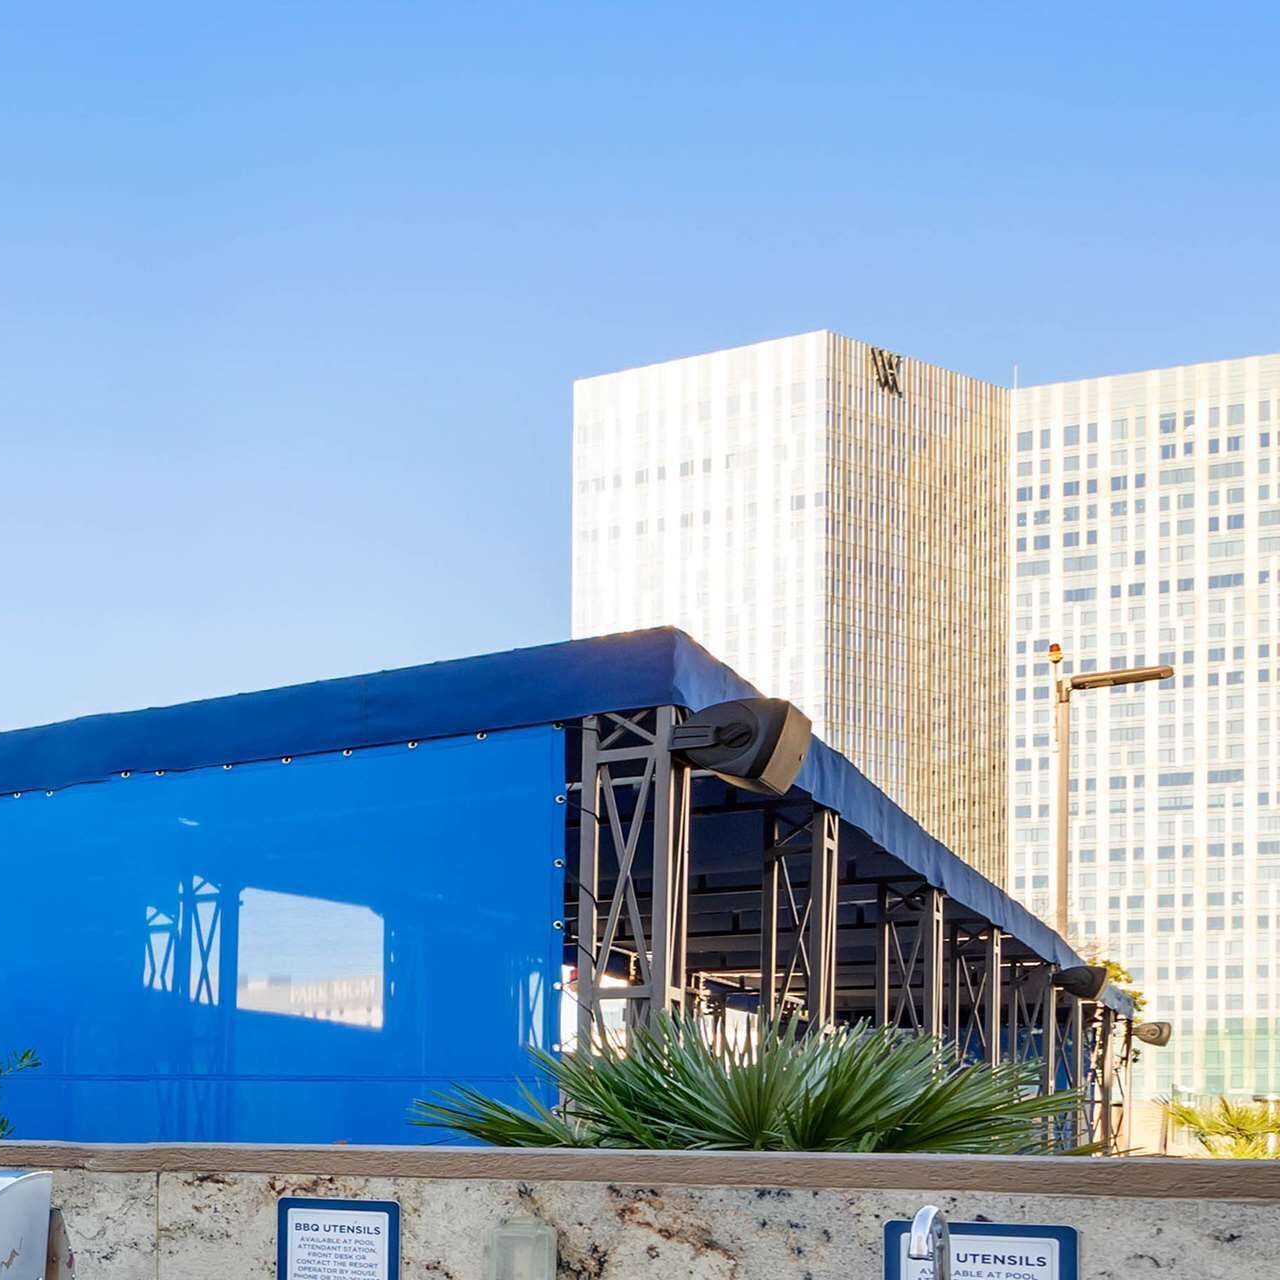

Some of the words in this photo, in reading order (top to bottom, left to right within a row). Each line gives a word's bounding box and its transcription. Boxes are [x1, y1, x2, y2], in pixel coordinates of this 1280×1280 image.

[295, 1222, 320, 1232] BBQ
[323, 1224, 381, 1235] UTENSILS
[956, 1252, 1047, 1267] UTENSILS
[1005, 1272, 1038, 1280] POOL
